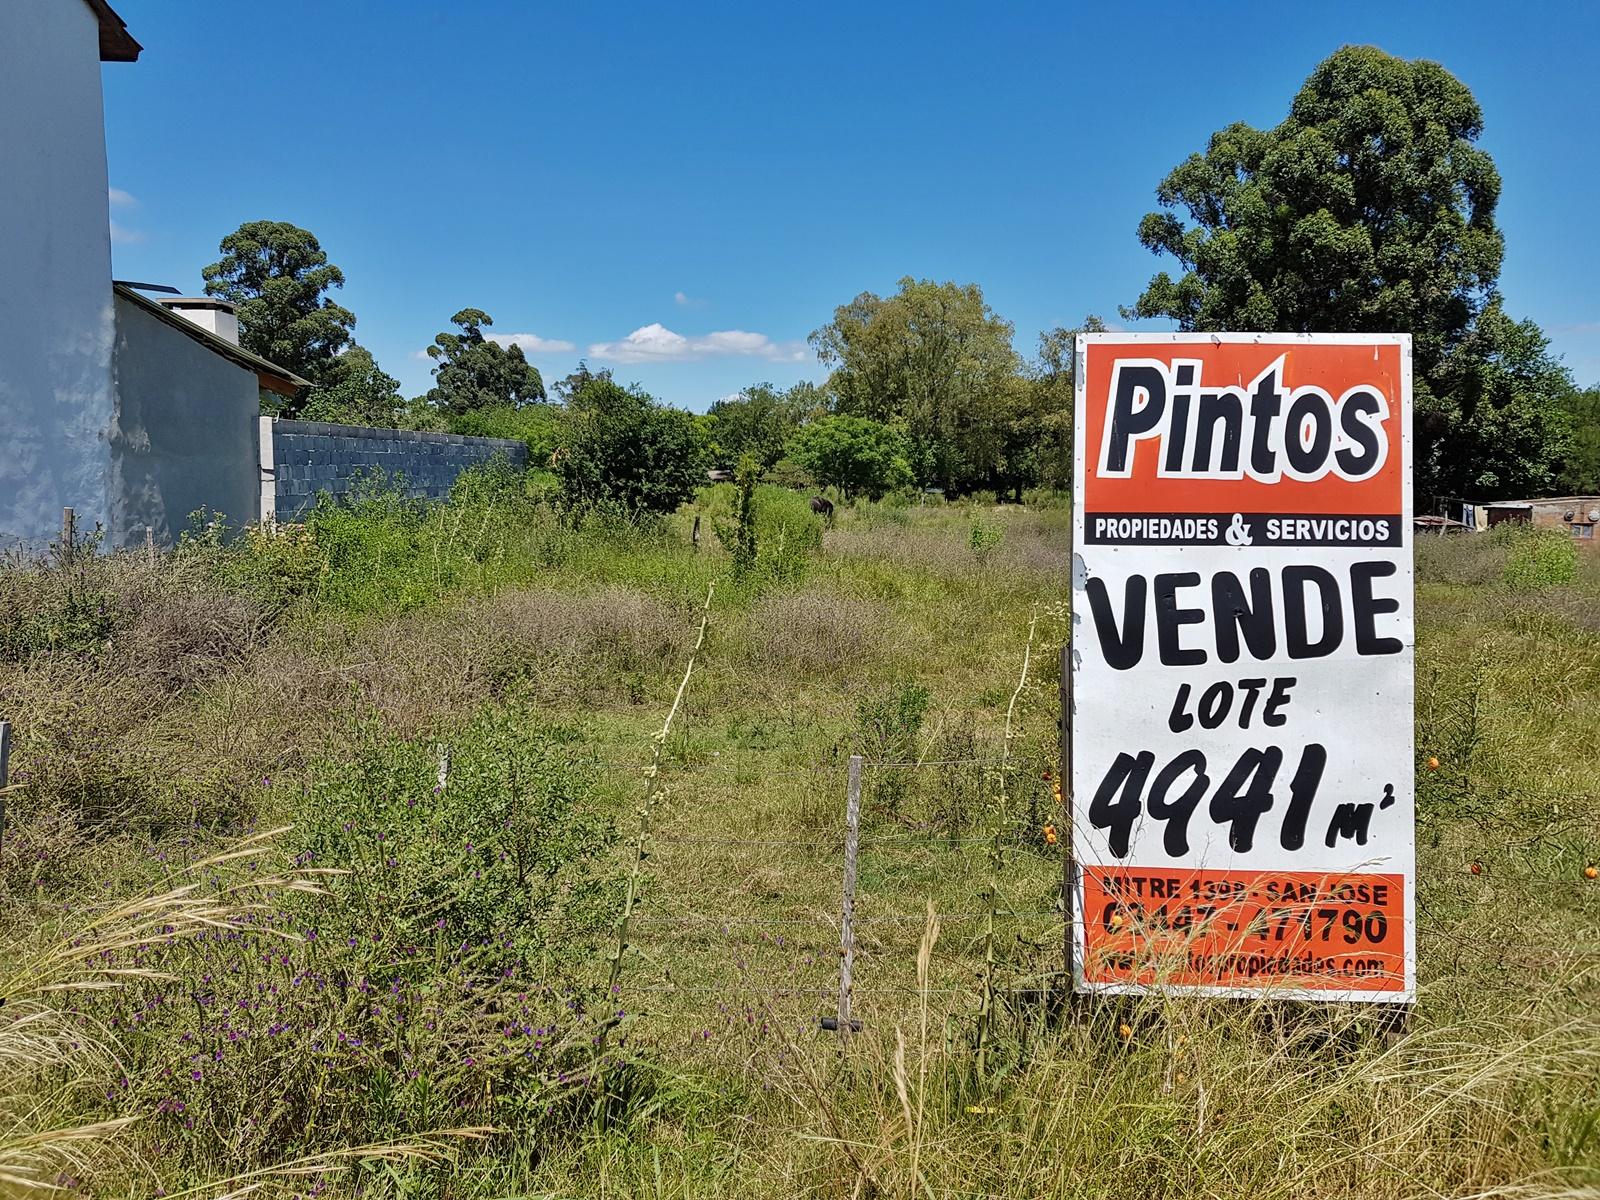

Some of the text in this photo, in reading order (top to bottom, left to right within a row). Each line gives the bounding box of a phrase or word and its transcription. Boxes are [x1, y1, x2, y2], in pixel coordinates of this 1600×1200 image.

[1097, 352, 1389, 483] Pintos
[1095, 513, 1390, 545] PROPIEDADES & SERVICIOS
[1085, 561, 1403, 670] VENDE
[1168, 677, 1297, 733] LOTE
[1088, 743, 1327, 859] 4941
[1103, 876, 1181, 898] MITRE
[1266, 881, 1317, 903] SAN
